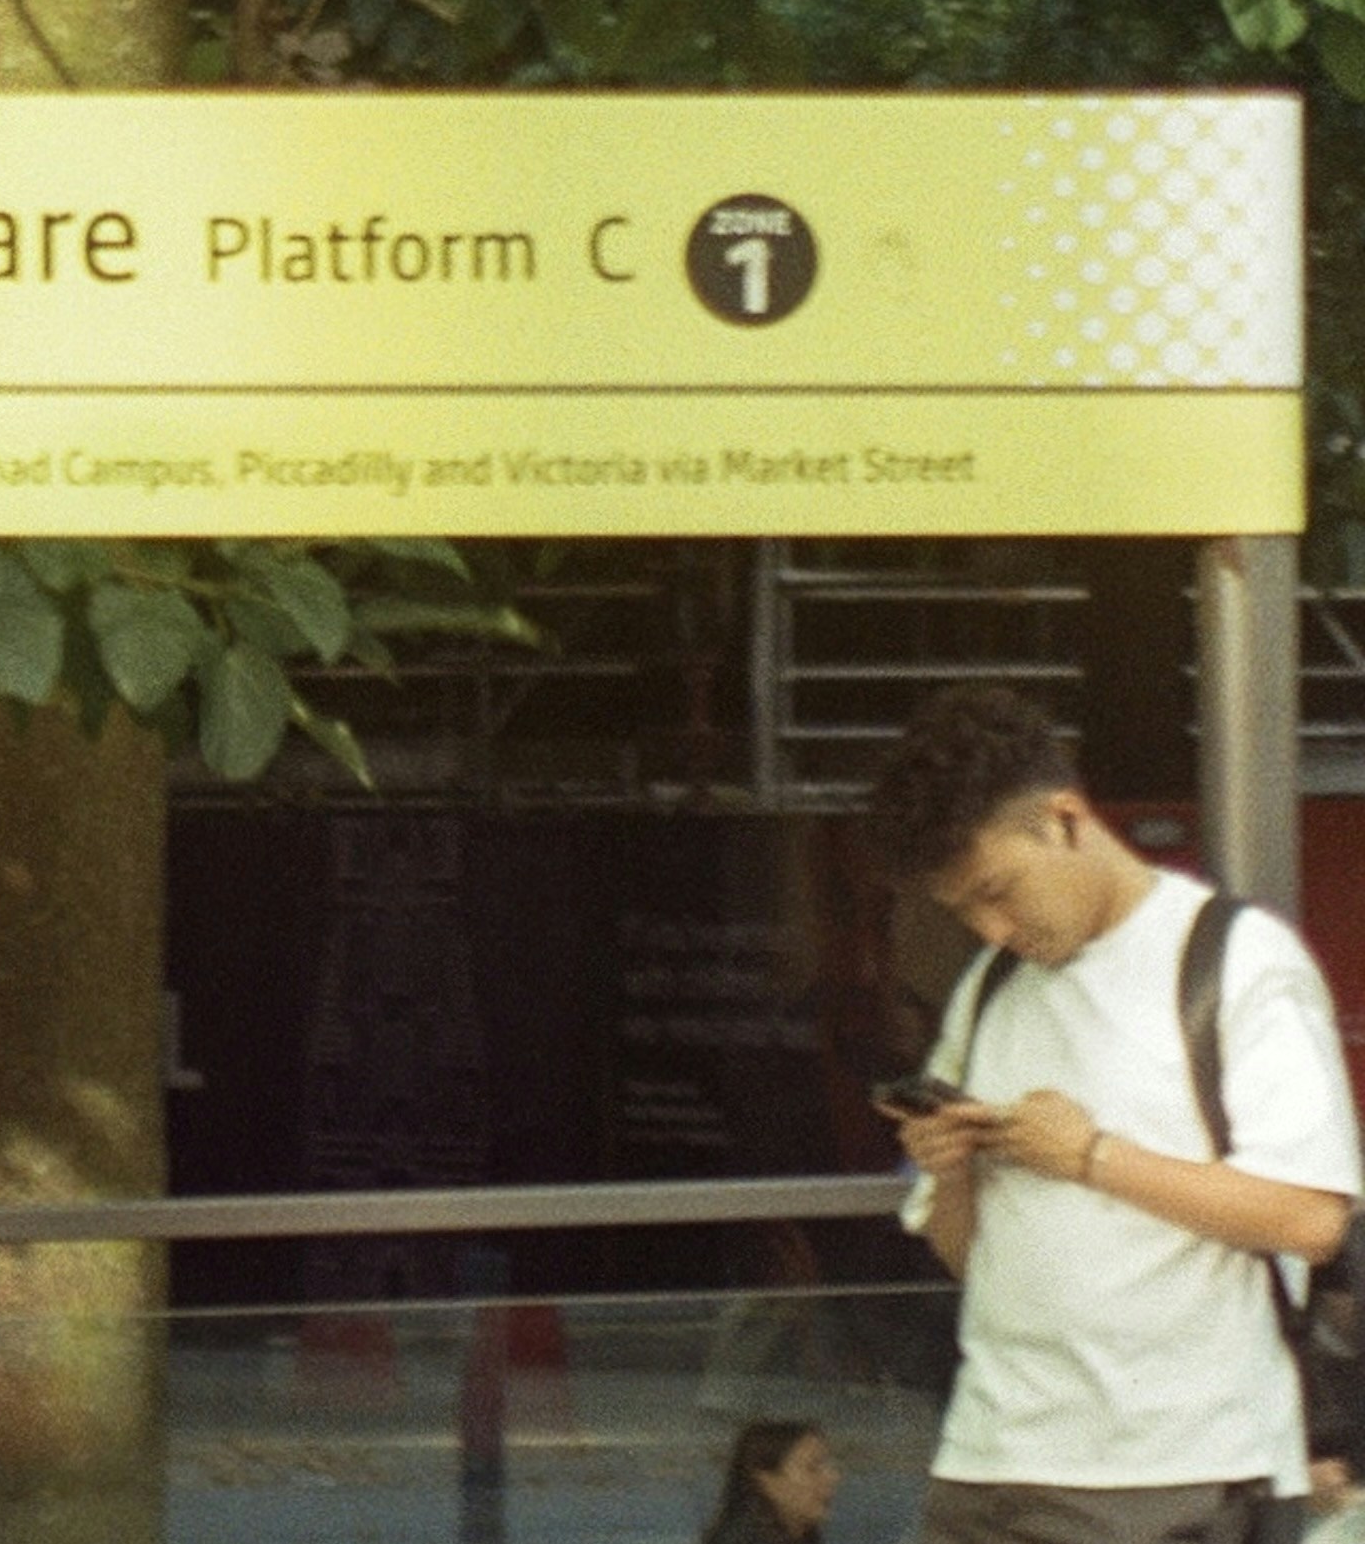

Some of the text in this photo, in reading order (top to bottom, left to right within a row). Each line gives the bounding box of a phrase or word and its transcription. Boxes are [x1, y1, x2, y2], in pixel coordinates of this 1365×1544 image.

[206, 212, 537, 285] Platform
[586, 212, 637, 284] C
[709, 208, 793, 235] ZONE
[724, 236, 770, 314] 1
[235, 448, 412, 497] Piccadilly
[422, 450, 493, 487] and
[502, 449, 648, 486] Victoria
[656, 453, 710, 485] via
[719, 449, 851, 485] Market
[861, 446, 976, 485] Street
